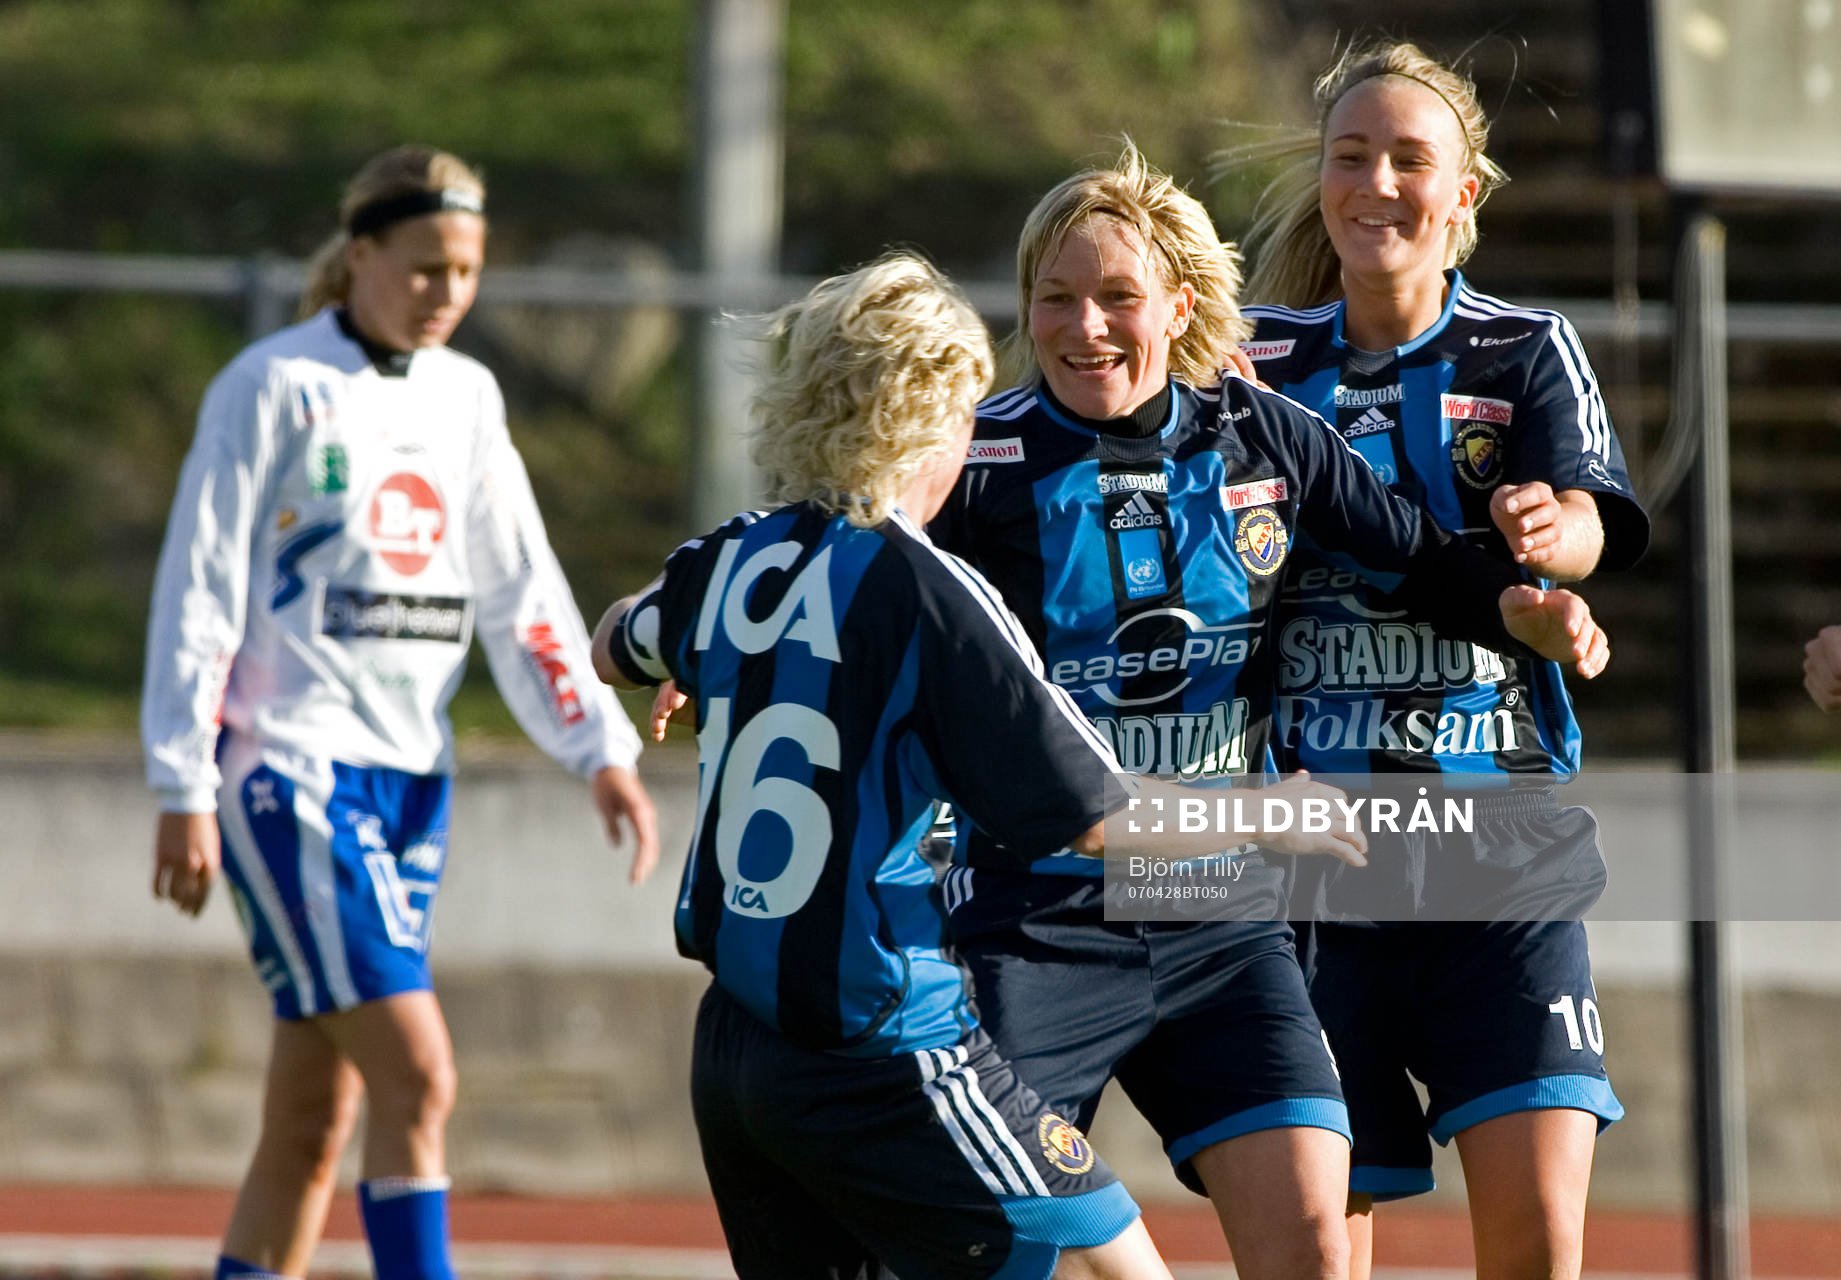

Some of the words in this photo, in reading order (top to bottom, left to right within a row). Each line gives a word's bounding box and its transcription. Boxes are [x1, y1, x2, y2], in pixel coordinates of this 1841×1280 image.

[1334, 384, 1405, 408] STADIUM
[1479, 402, 1511, 423] Class
[1344, 420, 1395, 437] adidas
[1097, 473, 1169, 495] STADIUM
[1110, 514, 1162, 529] adidas
[694, 538, 842, 663] ICA
[1087, 697, 1250, 783] ADIUM
[731, 884, 769, 913] ICA
[1549, 995, 1604, 1056] 10
